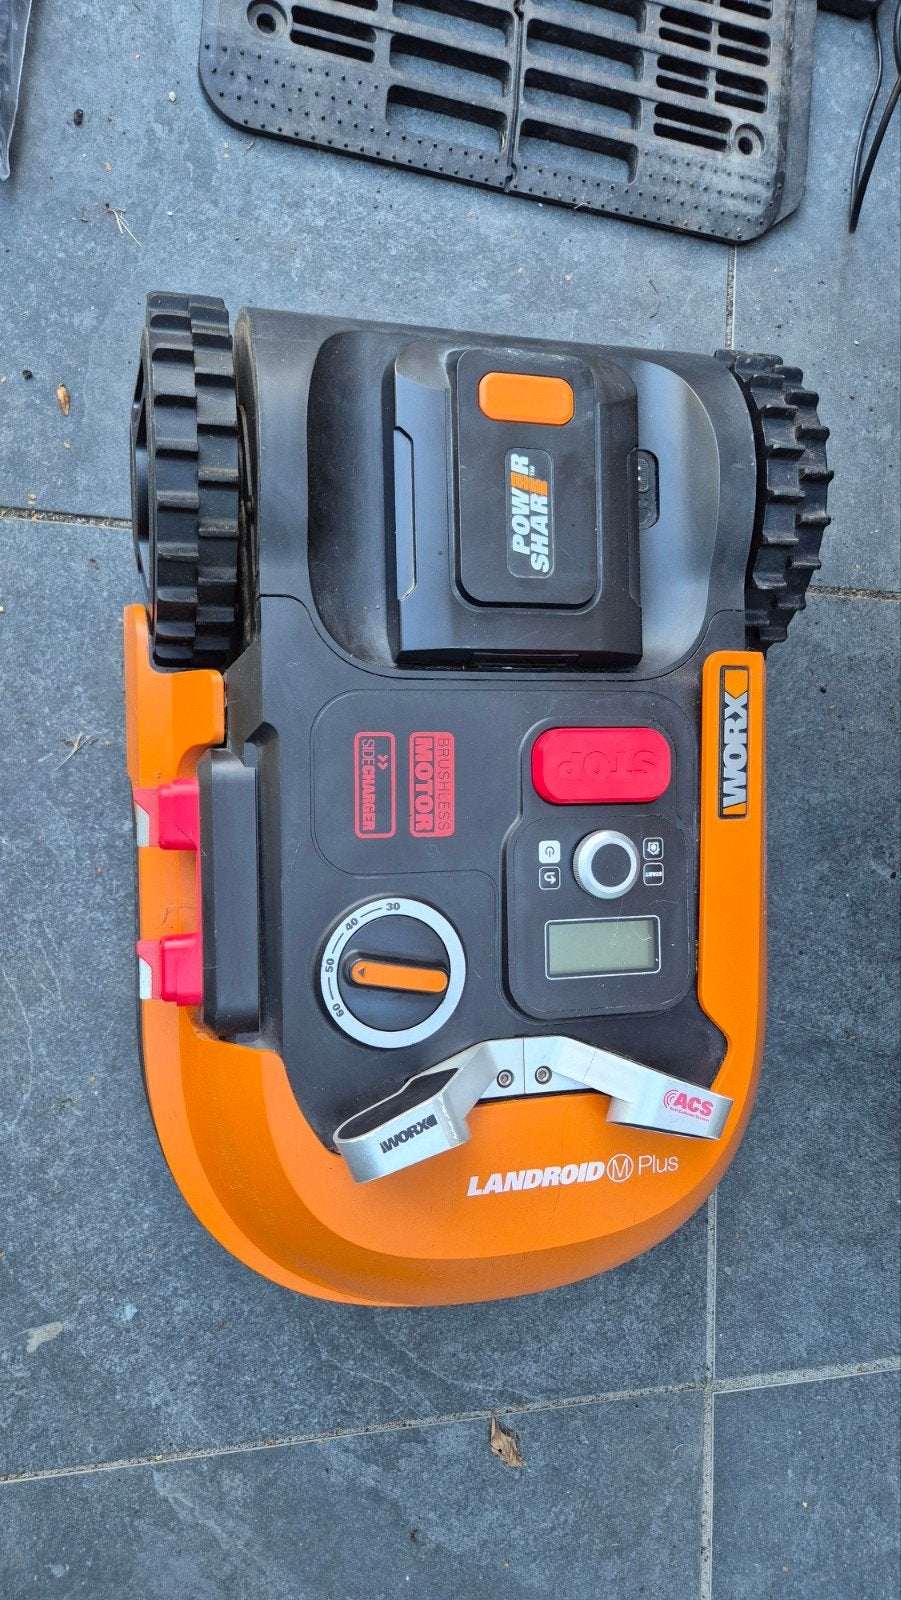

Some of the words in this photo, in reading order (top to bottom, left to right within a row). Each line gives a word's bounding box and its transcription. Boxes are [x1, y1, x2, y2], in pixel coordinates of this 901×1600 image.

[510, 453, 530, 555] POWER
[530, 478, 549, 573] SHARE
[557, 750, 657, 781] STOP
[723, 691, 748, 808] WORX
[415, 737, 433, 831] MOTOR
[438, 738, 450, 831] BRUSHLESS
[345, 917, 359, 931] 40
[385, 902, 400, 911] 30
[324, 957, 335, 973] 50
[332, 1002, 345, 1018] 60
[673, 1092, 713, 1117] ACS
[381, 1117, 432, 1154] WORX
[466, 1161, 605, 1197] LANDROID
[638, 1154, 679, 1176] Plus
